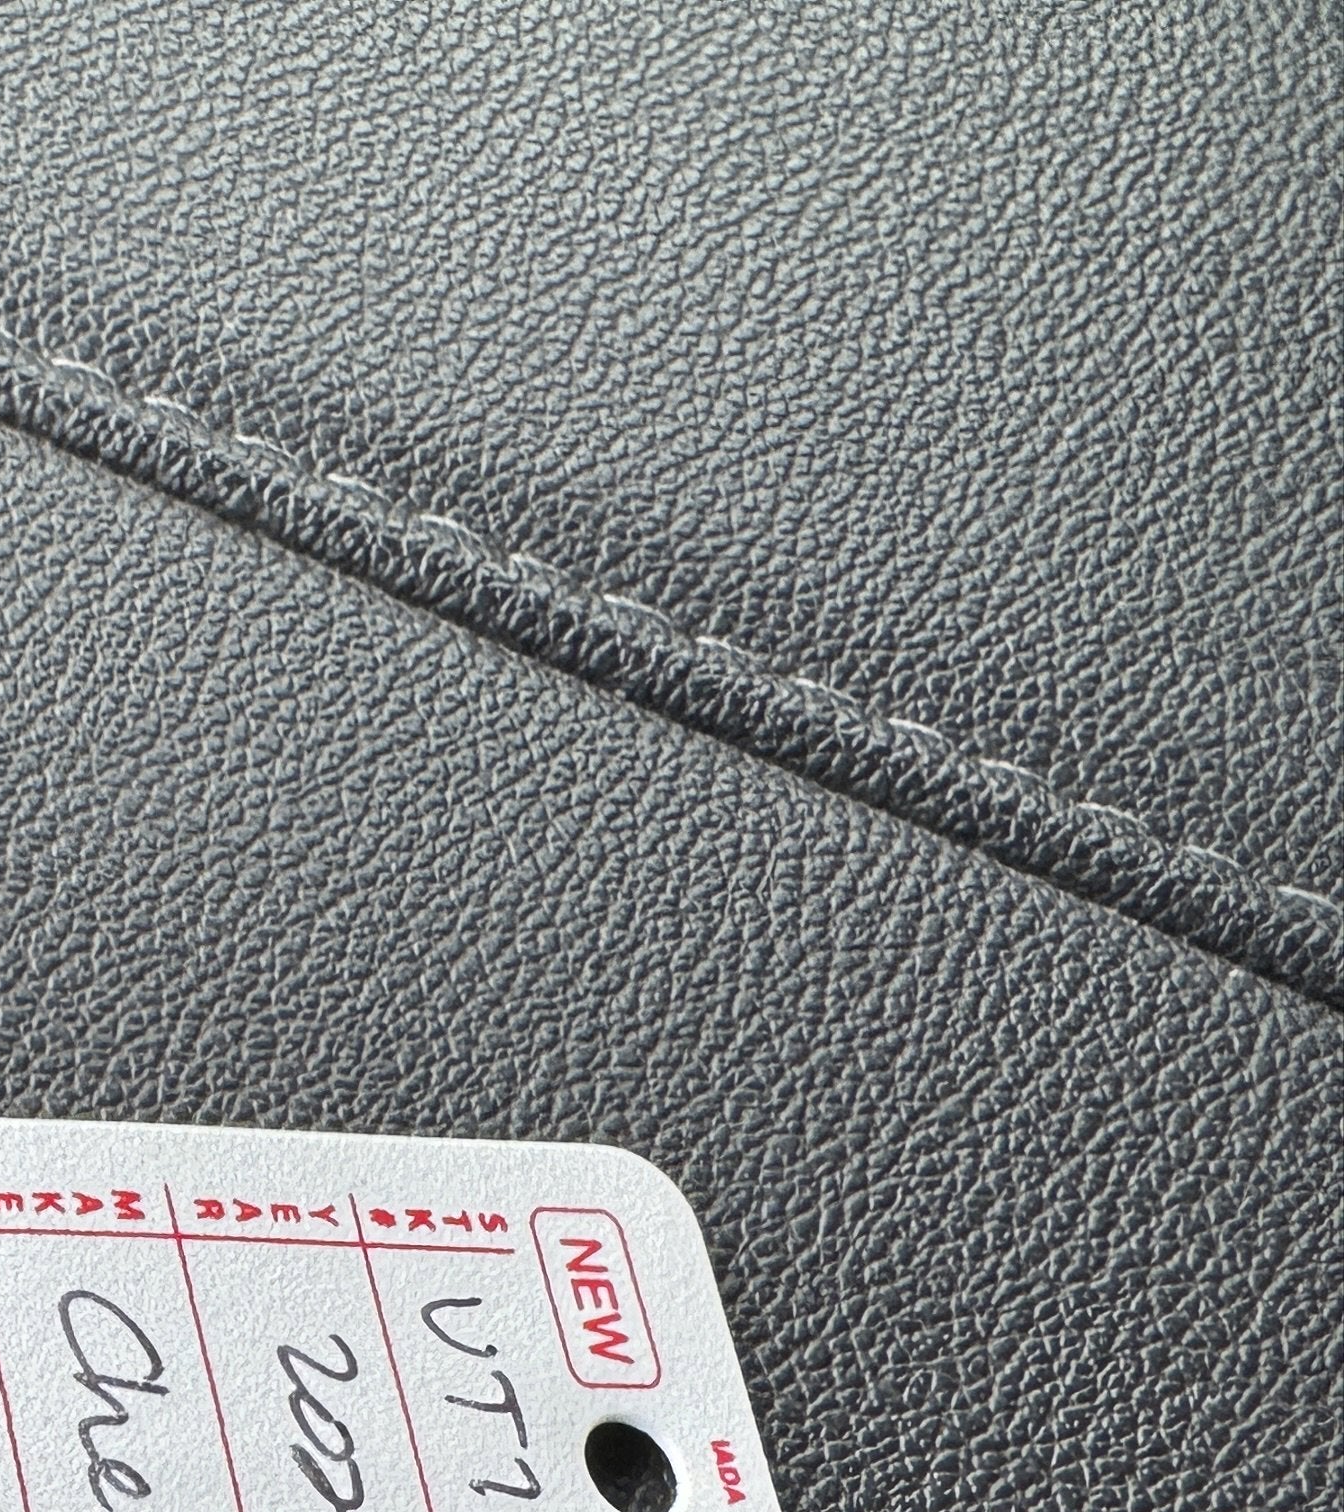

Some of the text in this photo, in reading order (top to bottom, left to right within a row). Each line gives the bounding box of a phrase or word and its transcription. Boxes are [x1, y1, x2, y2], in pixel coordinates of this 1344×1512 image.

[195, 1198, 341, 1228] YEAR
[559, 1236, 635, 1366] NEW
[711, 1438, 748, 1506] IADA
